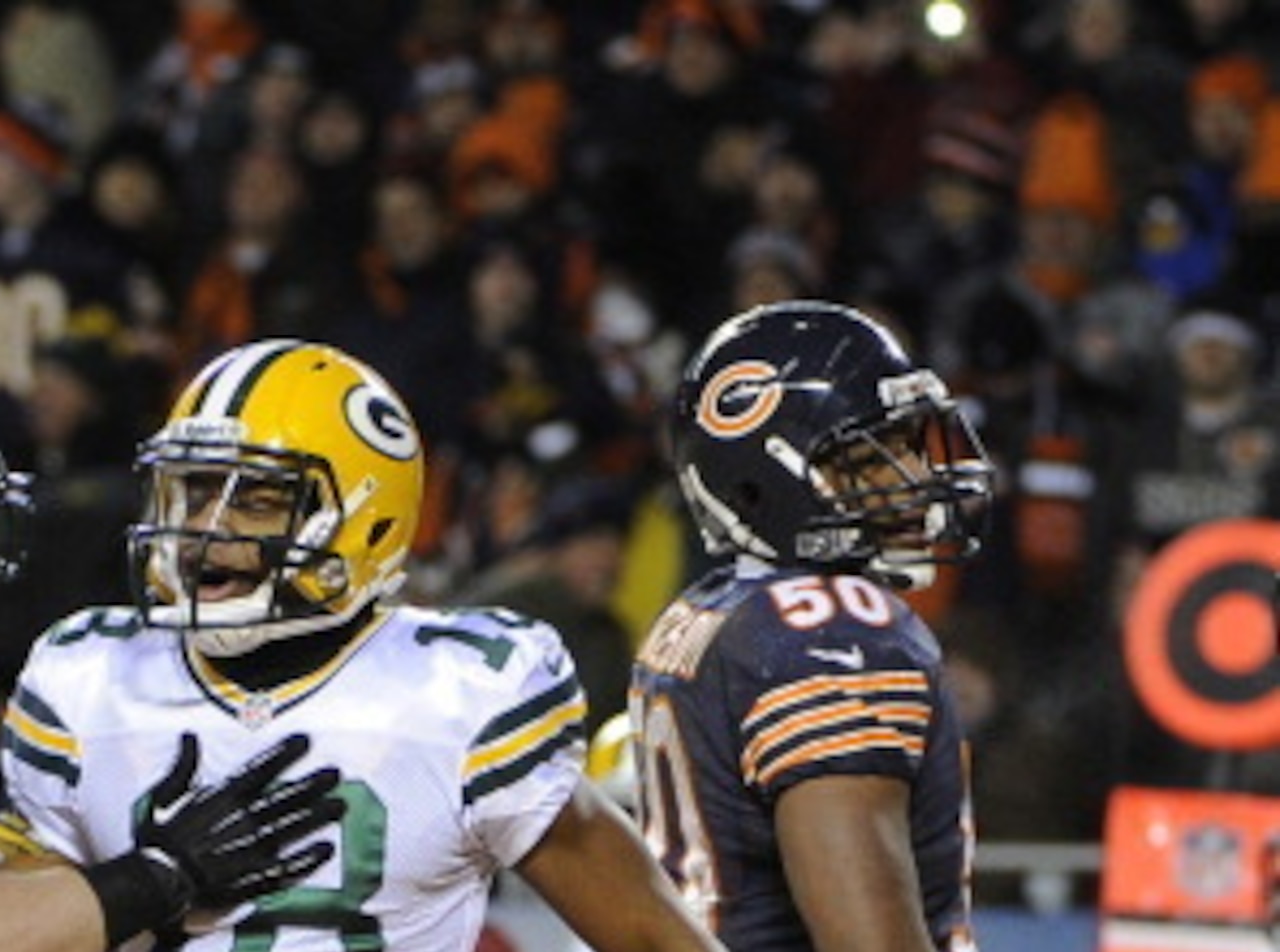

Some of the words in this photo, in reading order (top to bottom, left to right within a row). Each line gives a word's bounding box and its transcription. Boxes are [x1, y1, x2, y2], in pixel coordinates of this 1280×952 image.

[342, 381, 421, 461] G
[695, 360, 782, 439] C
[767, 572, 893, 630] 50
